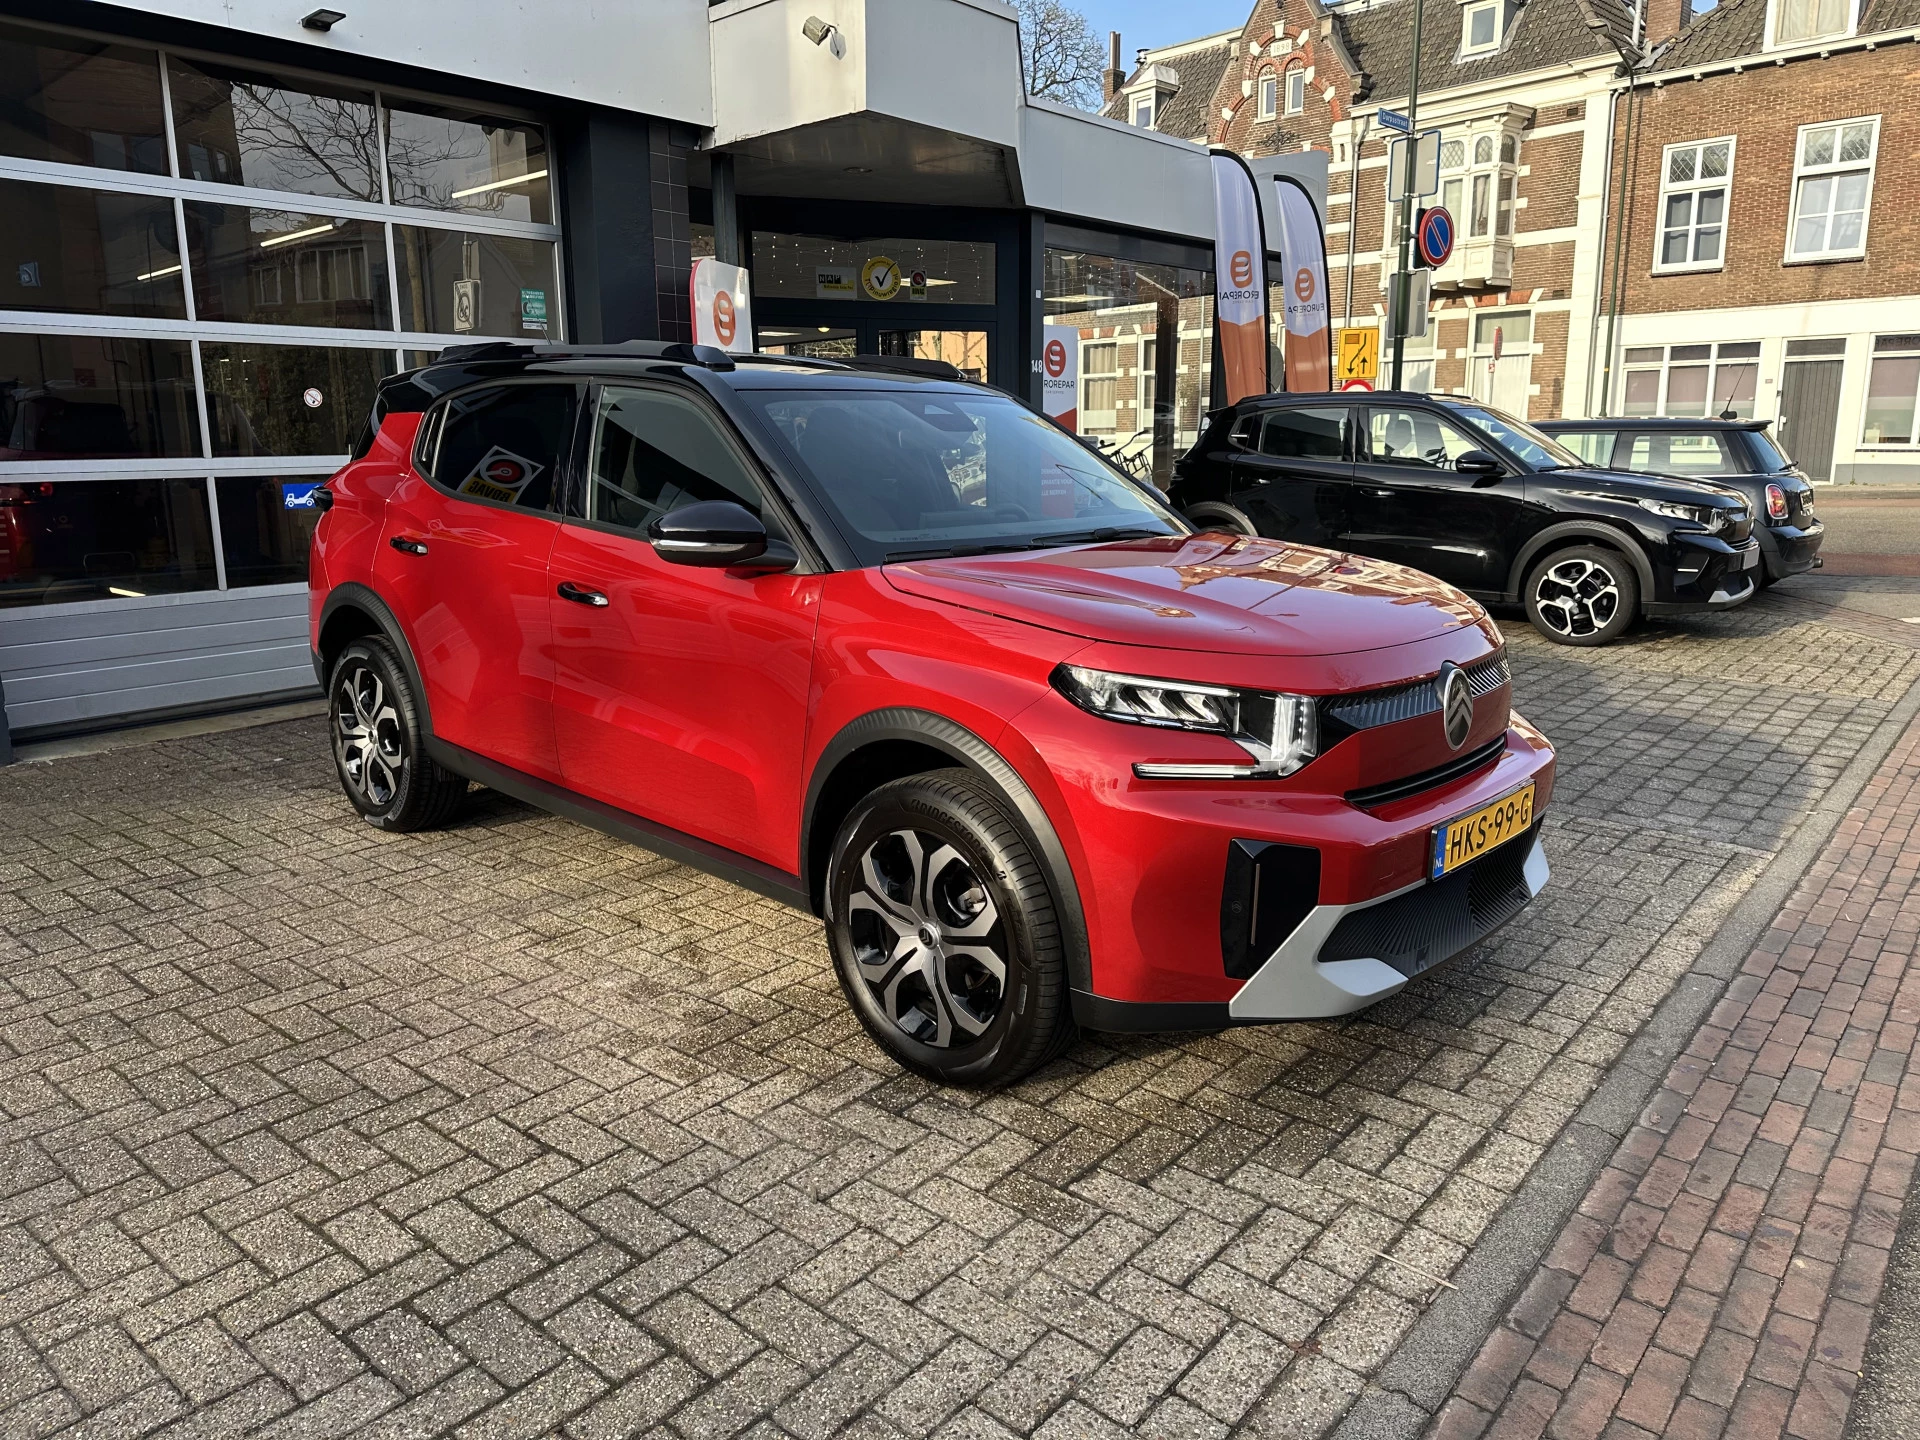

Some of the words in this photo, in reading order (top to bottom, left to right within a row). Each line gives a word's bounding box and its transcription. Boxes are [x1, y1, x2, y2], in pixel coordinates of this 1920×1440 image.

[1031, 359, 1043, 373] 148
[1449, 792, 1530, 864] HKS-99-G
[1435, 857, 1443, 869] NL
